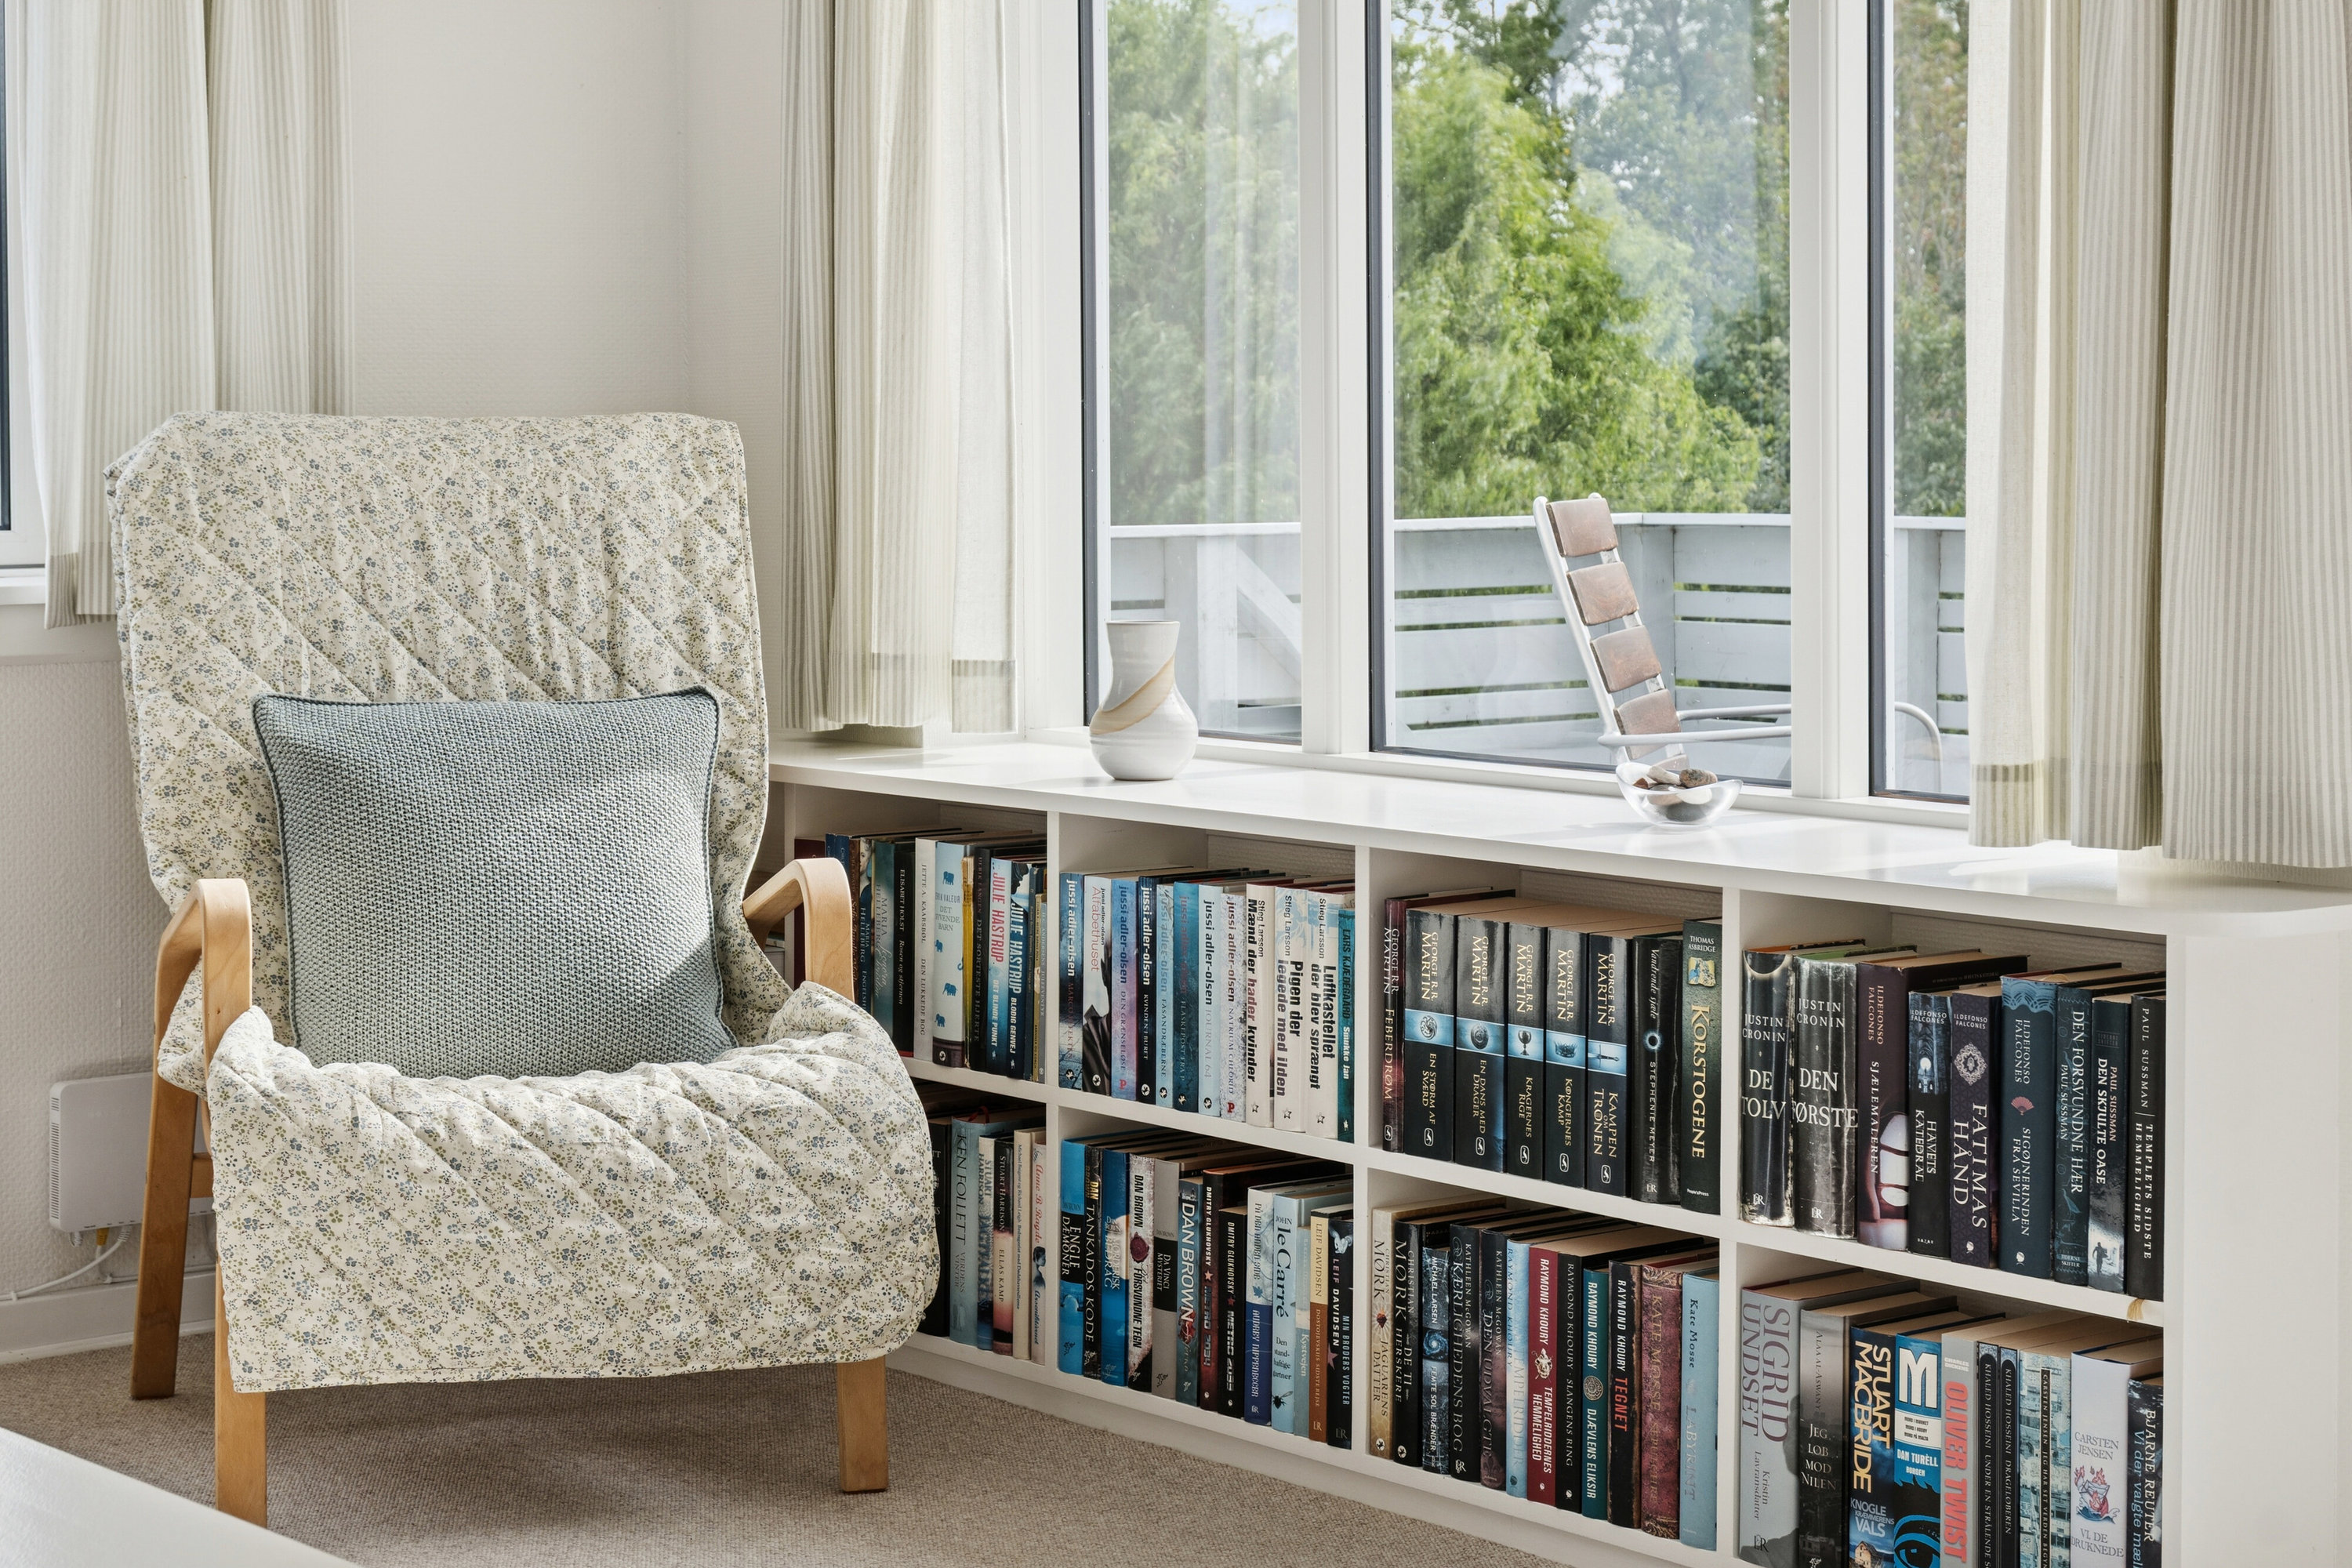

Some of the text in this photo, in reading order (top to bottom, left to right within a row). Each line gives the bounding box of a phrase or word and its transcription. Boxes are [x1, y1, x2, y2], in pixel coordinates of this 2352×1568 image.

[943, 893, 960, 904] VALEUR
[993, 873, 1005, 904] JULIE
[1066, 880, 1078, 908] jussi
[1226, 901, 1236, 930] jussi
[1318, 898, 1327, 920] Stieg
[991, 909, 1004, 963] HASTRUP
[1010, 902, 1023, 935] JULIE
[1091, 887, 1101, 972] Alfabethuset
[1342, 929, 1351, 953] LARS
[1690, 935, 1715, 945] THOMAS
[1008, 941, 1022, 994] HASTRUP
[1120, 916, 1129, 984] adler-olsen
[1142, 916, 1152, 985] adler-olsen
[1203, 900, 1214, 1005] jussi adler-olsen
[1421, 931, 1432, 1000] MARTIN
[1472, 936, 1483, 1005] MARTIN
[1650, 949, 1660, 994] Vandrende
[1688, 943, 1716, 953] ASBRIDGE
[1248, 949, 1258, 1083] der hader kvinder
[1289, 960, 1304, 1036] Pigen der
[1310, 964, 1322, 1025] der blev
[1323, 965, 1336, 1058] Luftkastellet
[1744, 1014, 1784, 1027] JUSTIN
[1796, 1013, 1845, 1028] CRONIN
[1798, 997, 1841, 1012] JUSTIN
[1276, 960, 1289, 1096] legede med ilden
[1385, 1009, 1395, 1100] FEBERDRØM
[1742, 1029, 1787, 1042] CRONIN
[2072, 1011, 2085, 1044] DEN
[1429, 1053, 1437, 1068] EN
[1479, 1060, 1486, 1073] EN
[1692, 1004, 1711, 1158] KORSTOGENE
[1749, 1069, 1773, 1091] DE
[1799, 1067, 1838, 1091] DEN
[2140, 1007, 2150, 1108] PAUL SUSSMAN
[1525, 1077, 1534, 1138] KRAGERNES
[1593, 1088, 1605, 1156] TRONEN
[1609, 1092, 1618, 1158] KAMPEN
[2096, 1058, 2107, 1185] DEN SKJULTE OASE
[1926, 1120, 1937, 1174] HAVETS
[1953, 1120, 1973, 1205] HÅND
[1972, 1102, 1987, 1229] FATIMAS
[956, 1134, 967, 1245] KEN FOLLETT
[1090, 1181, 1099, 1200] DAN
[1134, 1174, 1144, 1228] DAN BROWN
[2012, 1138, 2021, 1221] FRA SEVILLA
[1069, 1226, 1082, 1269] ENGLE
[1275, 1216, 1293, 1225] JOHN
[1085, 1205, 1095, 1342] TANKADOS KODE
[1163, 1254, 1171, 1289] DA VINCI
[1181, 1203, 1196, 1322] DAN BROWN
[1276, 1226, 1291, 1318] le Carré
[1374, 1240, 1385, 1300] MØRK
[1395, 1240, 1407, 1322] MØRK
[1132, 1268, 1142, 1348] FORSVUNDNE TEGN
[1539, 1258, 1550, 1345] RAYMOND KHOURY
[1587, 1282, 1598, 1370] RAYMOND KHOURY
[1276, 1337, 1287, 1346] Den
[1403, 1348, 1412, 1366] DE
[1742, 1303, 1762, 1437] UNDSET
[1762, 1305, 1791, 1442] SIGRID
[1872, 1345, 1891, 1449] STUART
[1899, 1346, 1938, 1410] M
[1543, 1387, 1553, 1474] TEMPELRIDDERNES
[1614, 1377, 1628, 1432] TEGNET
[1809, 1423, 1828, 1439] JEG
[1853, 1341, 1873, 1493] MACBRIDE
[1453, 1413, 1463, 1452] BOG
[1897, 1448, 1910, 1461] DAN
[2074, 1431, 2119, 1450] CARSTEN
[2145, 1410, 2156, 1472] BJARNE
[1586, 1462, 1597, 1499] ELIKSIR
[1801, 1472, 1837, 1490] NILEN
[1806, 1459, 1832, 1474] MOD
[1906, 1466, 1926, 1476] BORGEN
[1944, 1381, 1968, 1563] OLIVER TWIST
[2131, 1430, 2145, 1528] Vi der valgte
[1850, 1497, 1886, 1517] KNOGLE
[1855, 1516, 1886, 1537] VALS
[2093, 1533, 2108, 1543] DE
